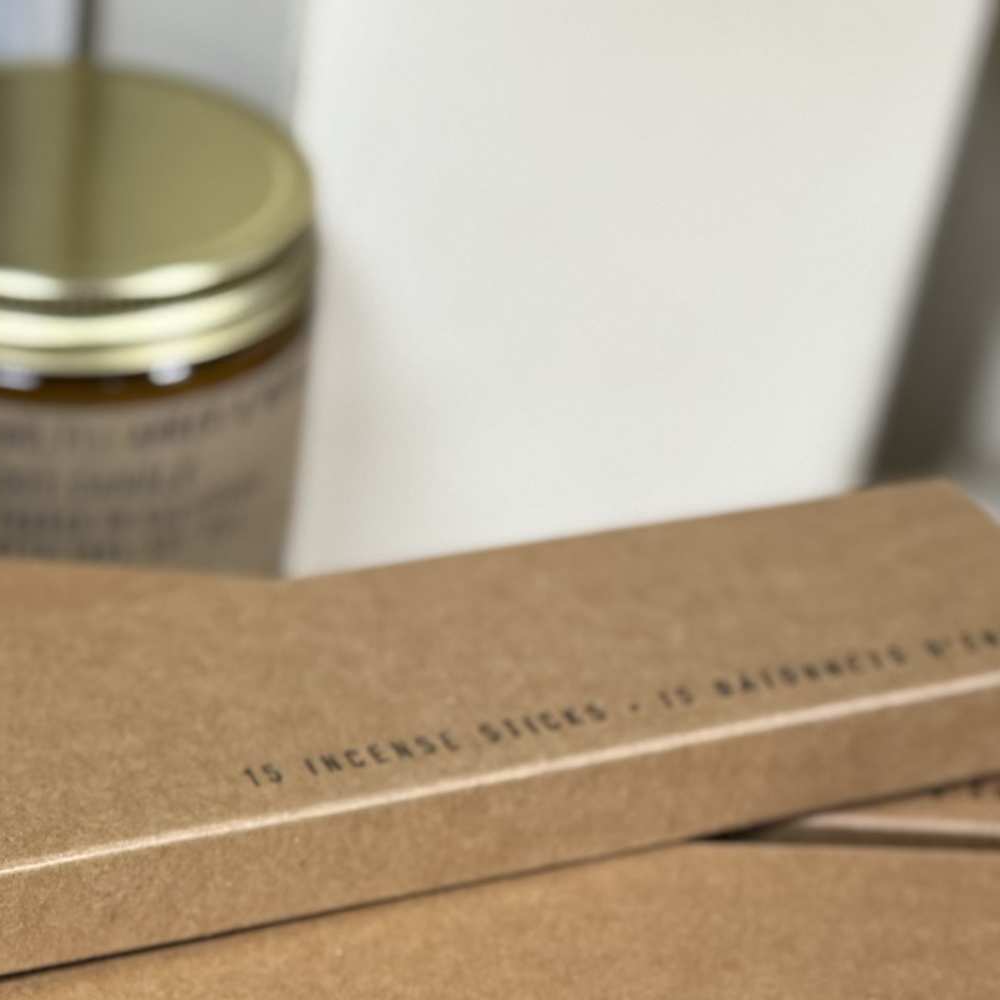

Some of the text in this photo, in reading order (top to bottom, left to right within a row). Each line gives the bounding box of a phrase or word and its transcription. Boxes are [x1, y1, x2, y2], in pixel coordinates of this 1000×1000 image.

[243, 763, 283, 787] 15
[304, 731, 460, 776] INCENSE
[478, 703, 607, 743] STICKS
